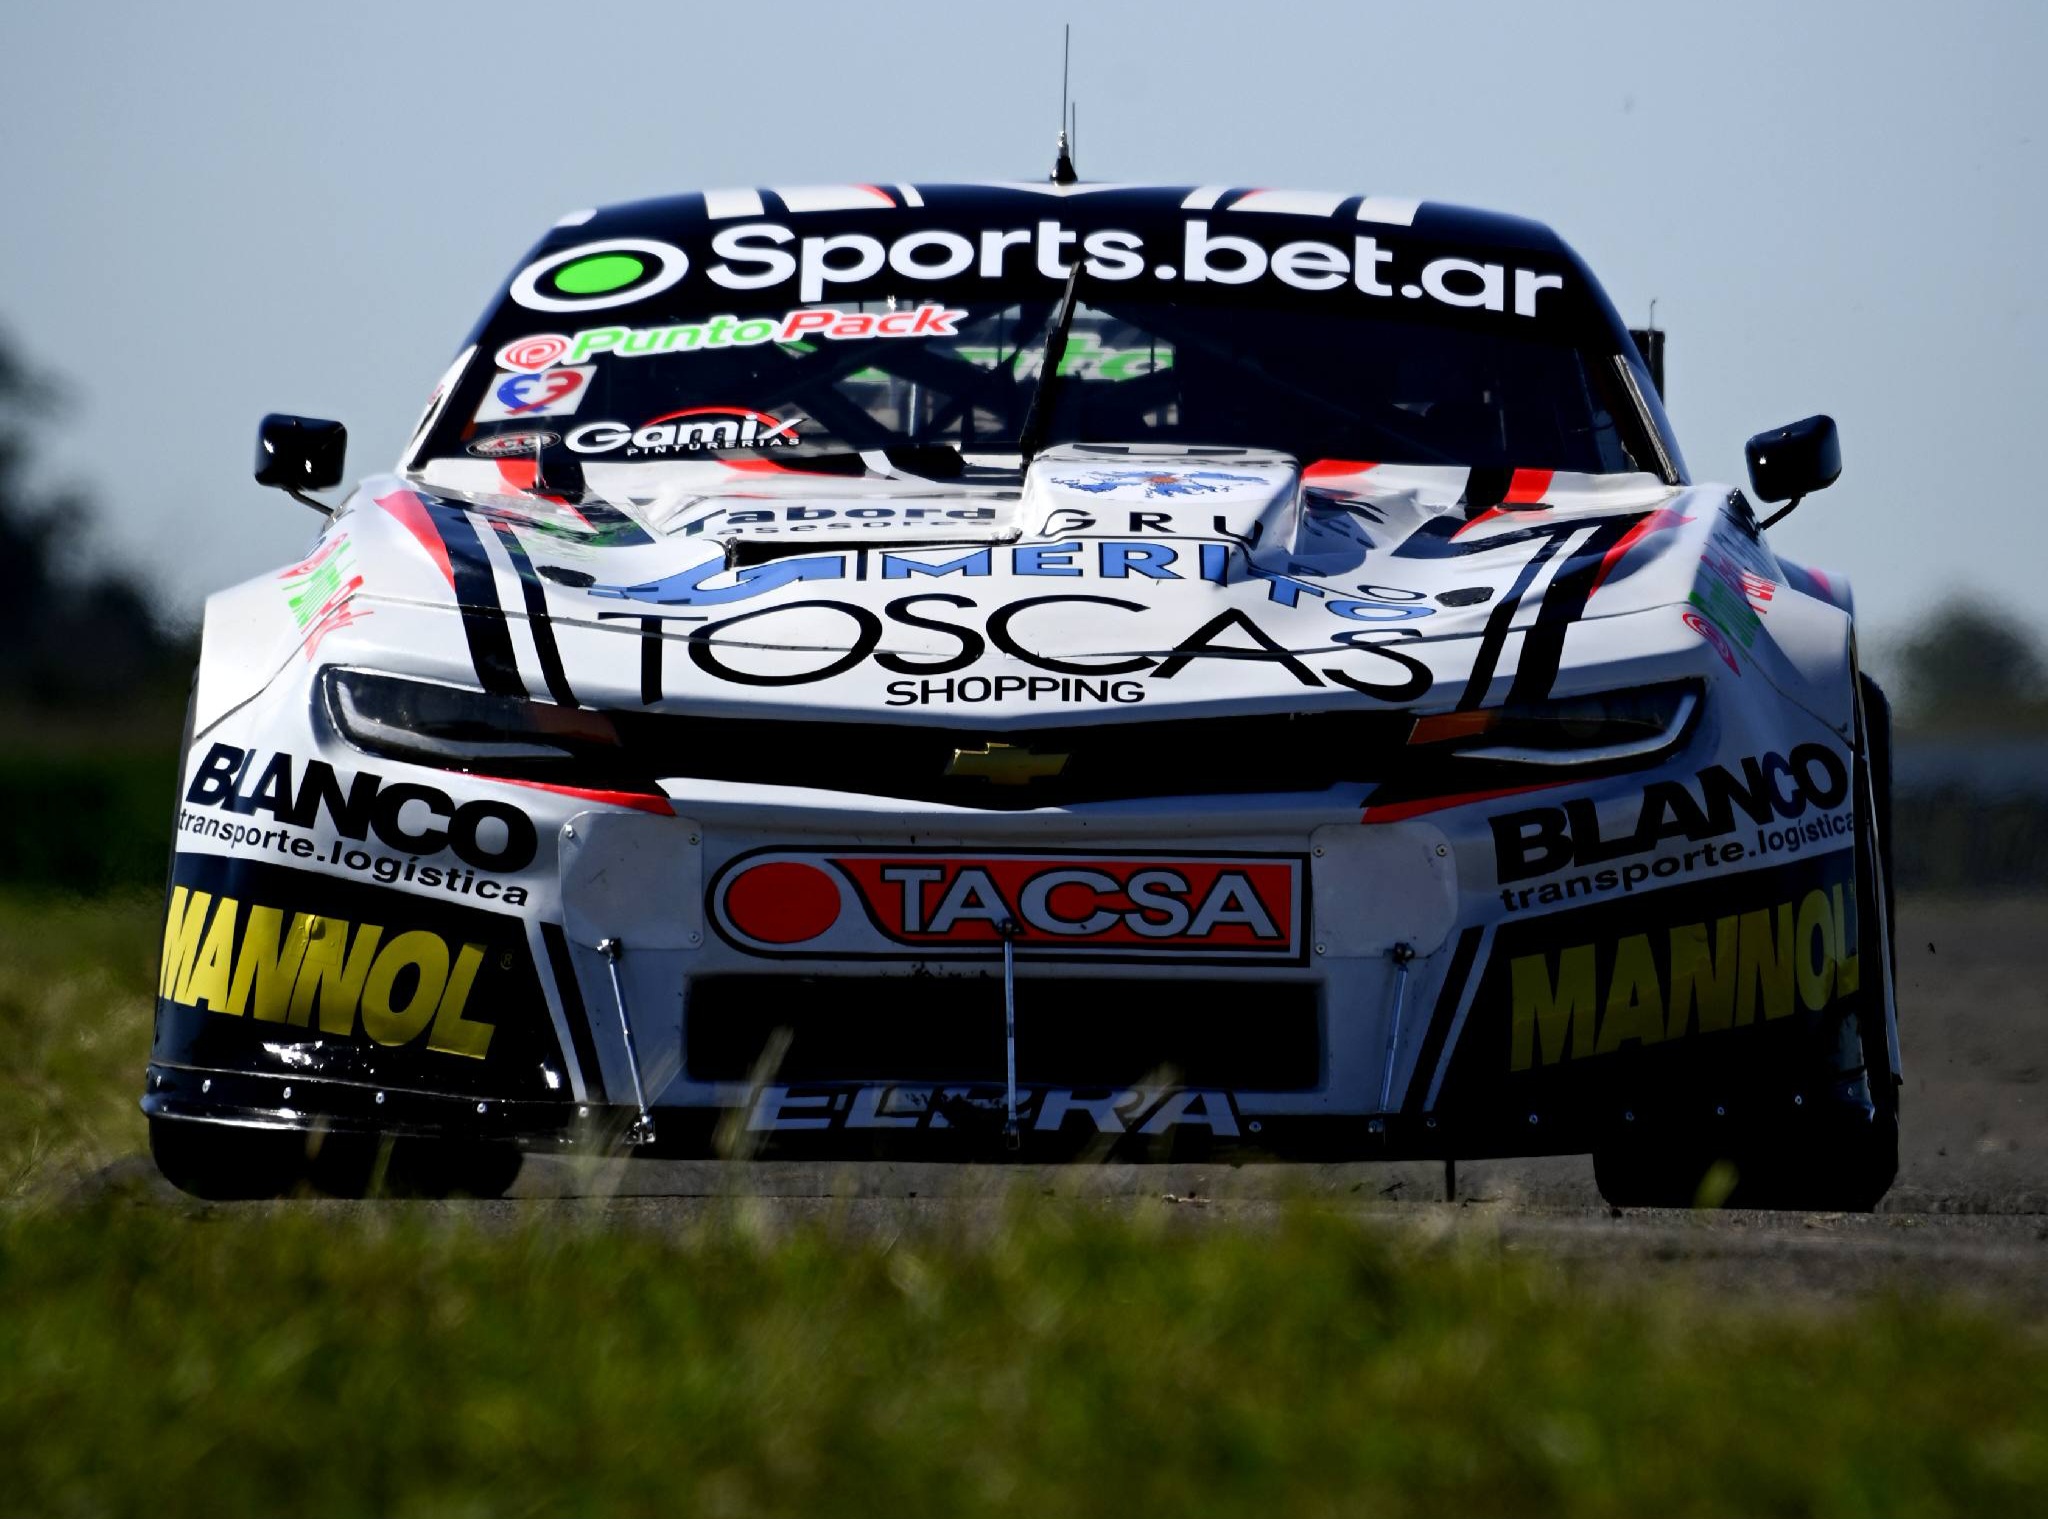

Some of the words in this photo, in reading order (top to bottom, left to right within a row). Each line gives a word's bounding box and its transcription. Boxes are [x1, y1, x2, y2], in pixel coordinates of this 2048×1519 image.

[706, 221, 1563, 318] Sports.bet.ar
[570, 306, 963, 362] PuntoPack
[565, 413, 806, 454] Gamix
[627, 438, 800, 457] PINTURERIAS
[598, 592, 1434, 706] TOSCAS
[885, 675, 1146, 707] SHOPPING
[186, 742, 538, 873] BLANCO
[1488, 742, 1849, 884] BLANCO
[880, 864, 1285, 940] TACSA
[159, 884, 497, 1060] MANNOL
[1510, 881, 1860, 1073] MANNOL
